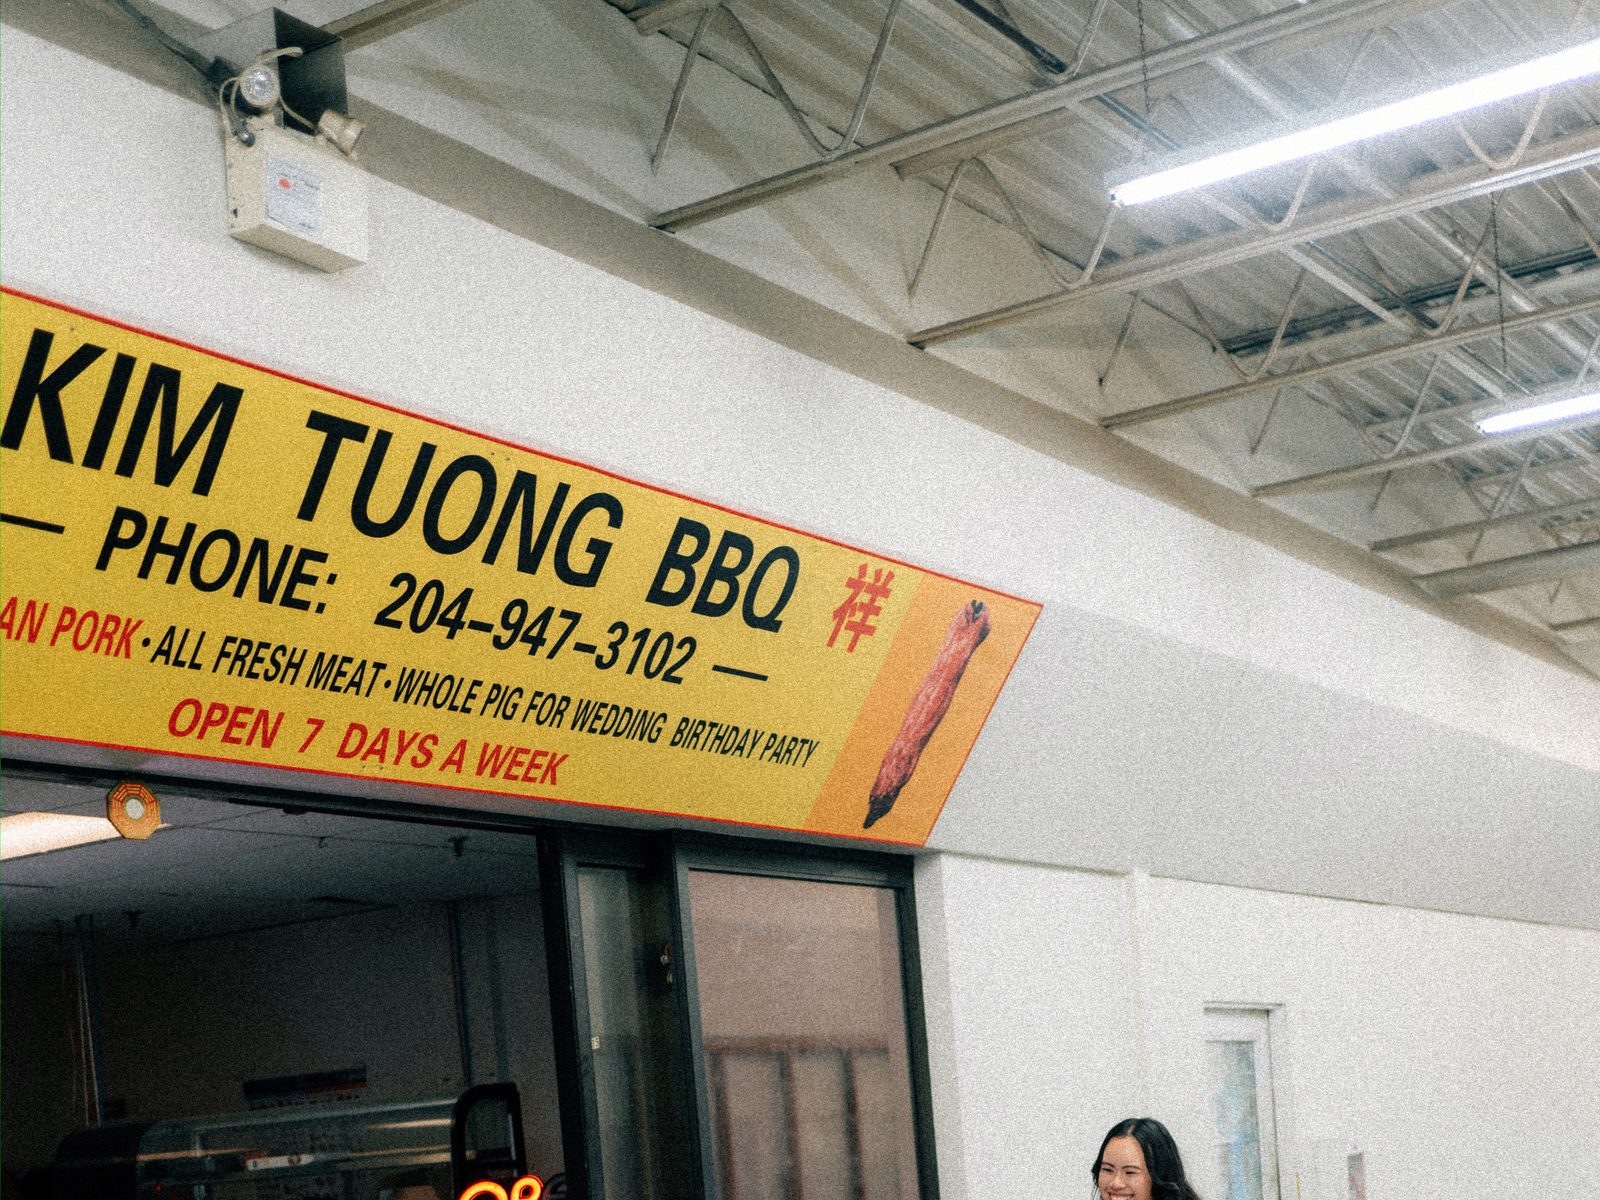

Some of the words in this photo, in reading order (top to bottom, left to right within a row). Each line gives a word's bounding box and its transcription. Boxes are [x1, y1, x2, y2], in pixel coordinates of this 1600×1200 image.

[0, 328, 244, 497] KIM
[296, 410, 624, 588] TUONG
[645, 516, 800, 633] BBQ
[95, 505, 338, 614] PHONE:
[50, 606, 144, 660] PORK
[150, 625, 206, 672] ALL
[212, 635, 308, 686] FRESH
[305, 651, 388, 698] MEAT
[393, 666, 484, 714] WHOLE
[483, 683, 524, 721] PIG
[521, 690, 570, 730] FOR
[570, 698, 668, 745] WEDDING
[669, 716, 765, 759] BIRTHDAY
[764, 732, 819, 767] PARTY
[168, 698, 285, 749] OPEN
[298, 717, 325, 753] 7
[336, 722, 439, 769] DAYS
[438, 739, 468, 774] A
[475, 742, 569, 786] WEEK
